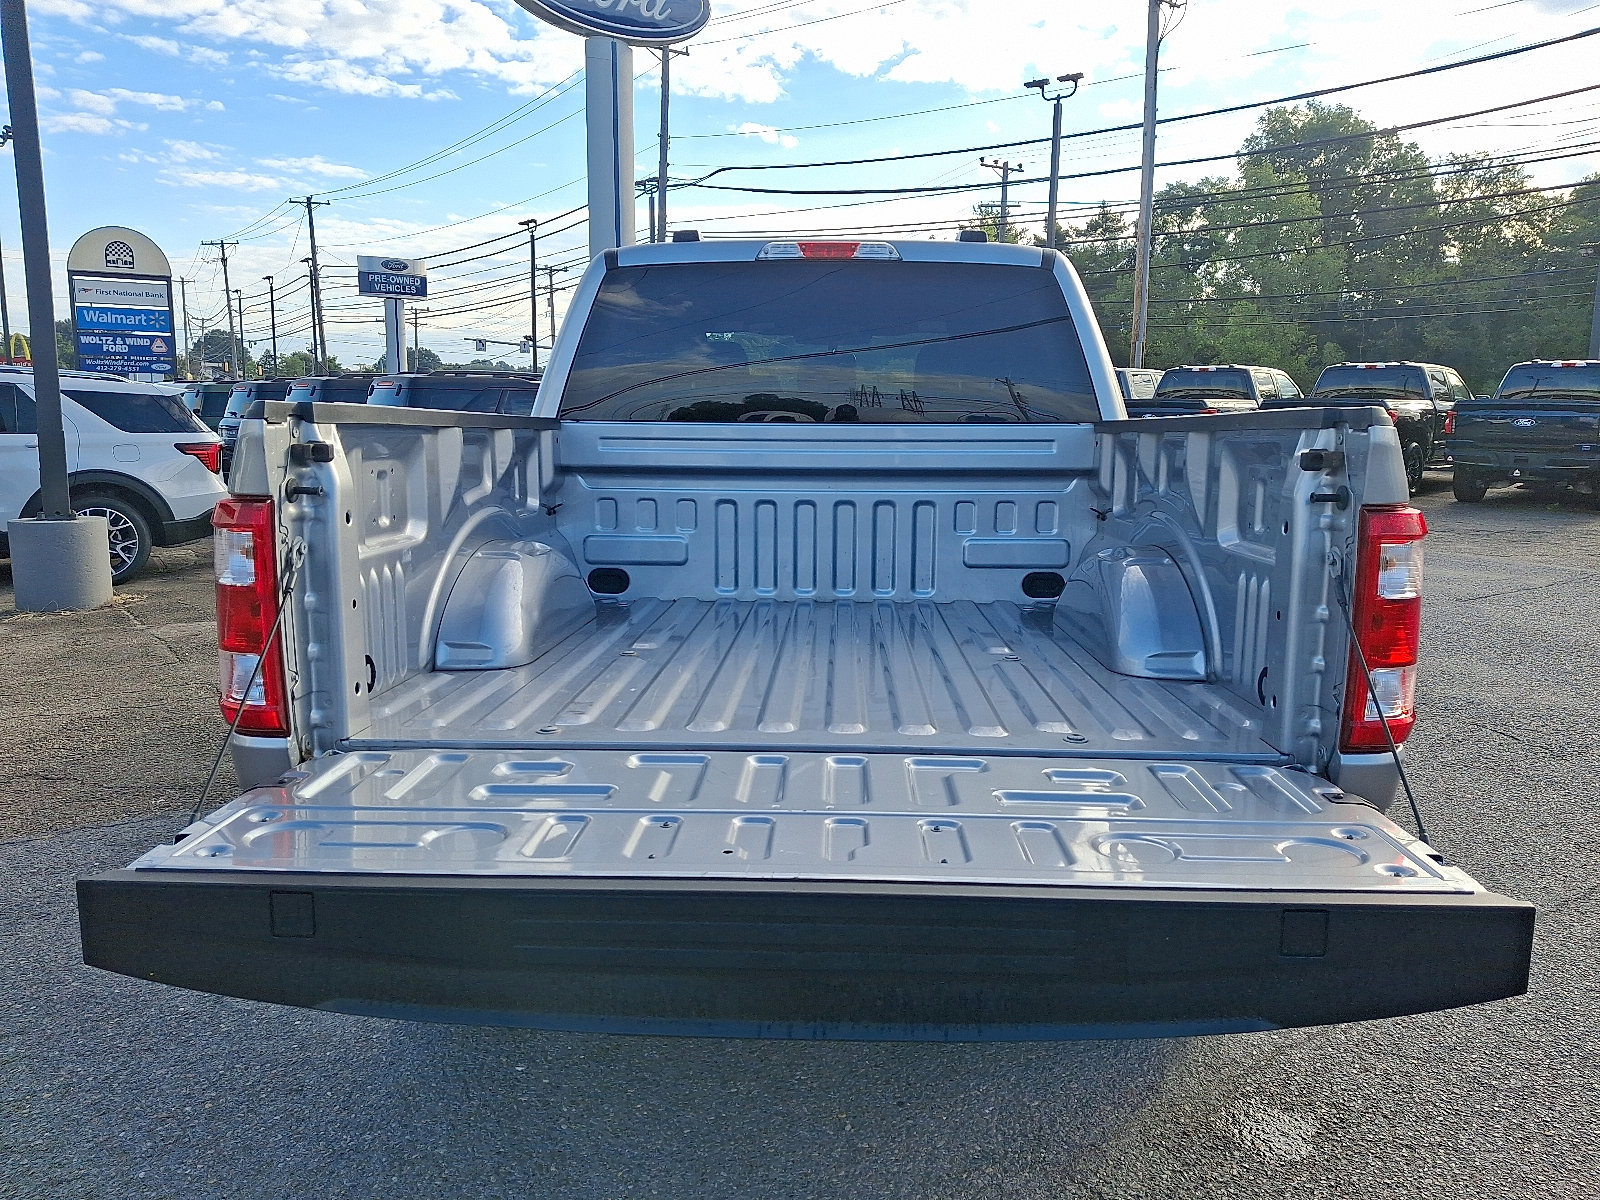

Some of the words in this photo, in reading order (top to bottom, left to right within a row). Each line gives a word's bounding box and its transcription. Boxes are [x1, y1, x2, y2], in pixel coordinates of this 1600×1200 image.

[369, 274, 421, 286] PRE-OWNED
[95, 288, 112, 296] First
[113, 289, 144, 297] National
[375, 284, 416, 294] VEHICLES
[83, 309, 148, 326] Walmart
[79, 335, 115, 344] WOLTZ
[116, 337, 124, 345] &
[124, 337, 151, 346] WIND
[102, 344, 129, 353] FORD
[85, 358, 150, 367] WoltzWindFord.com
